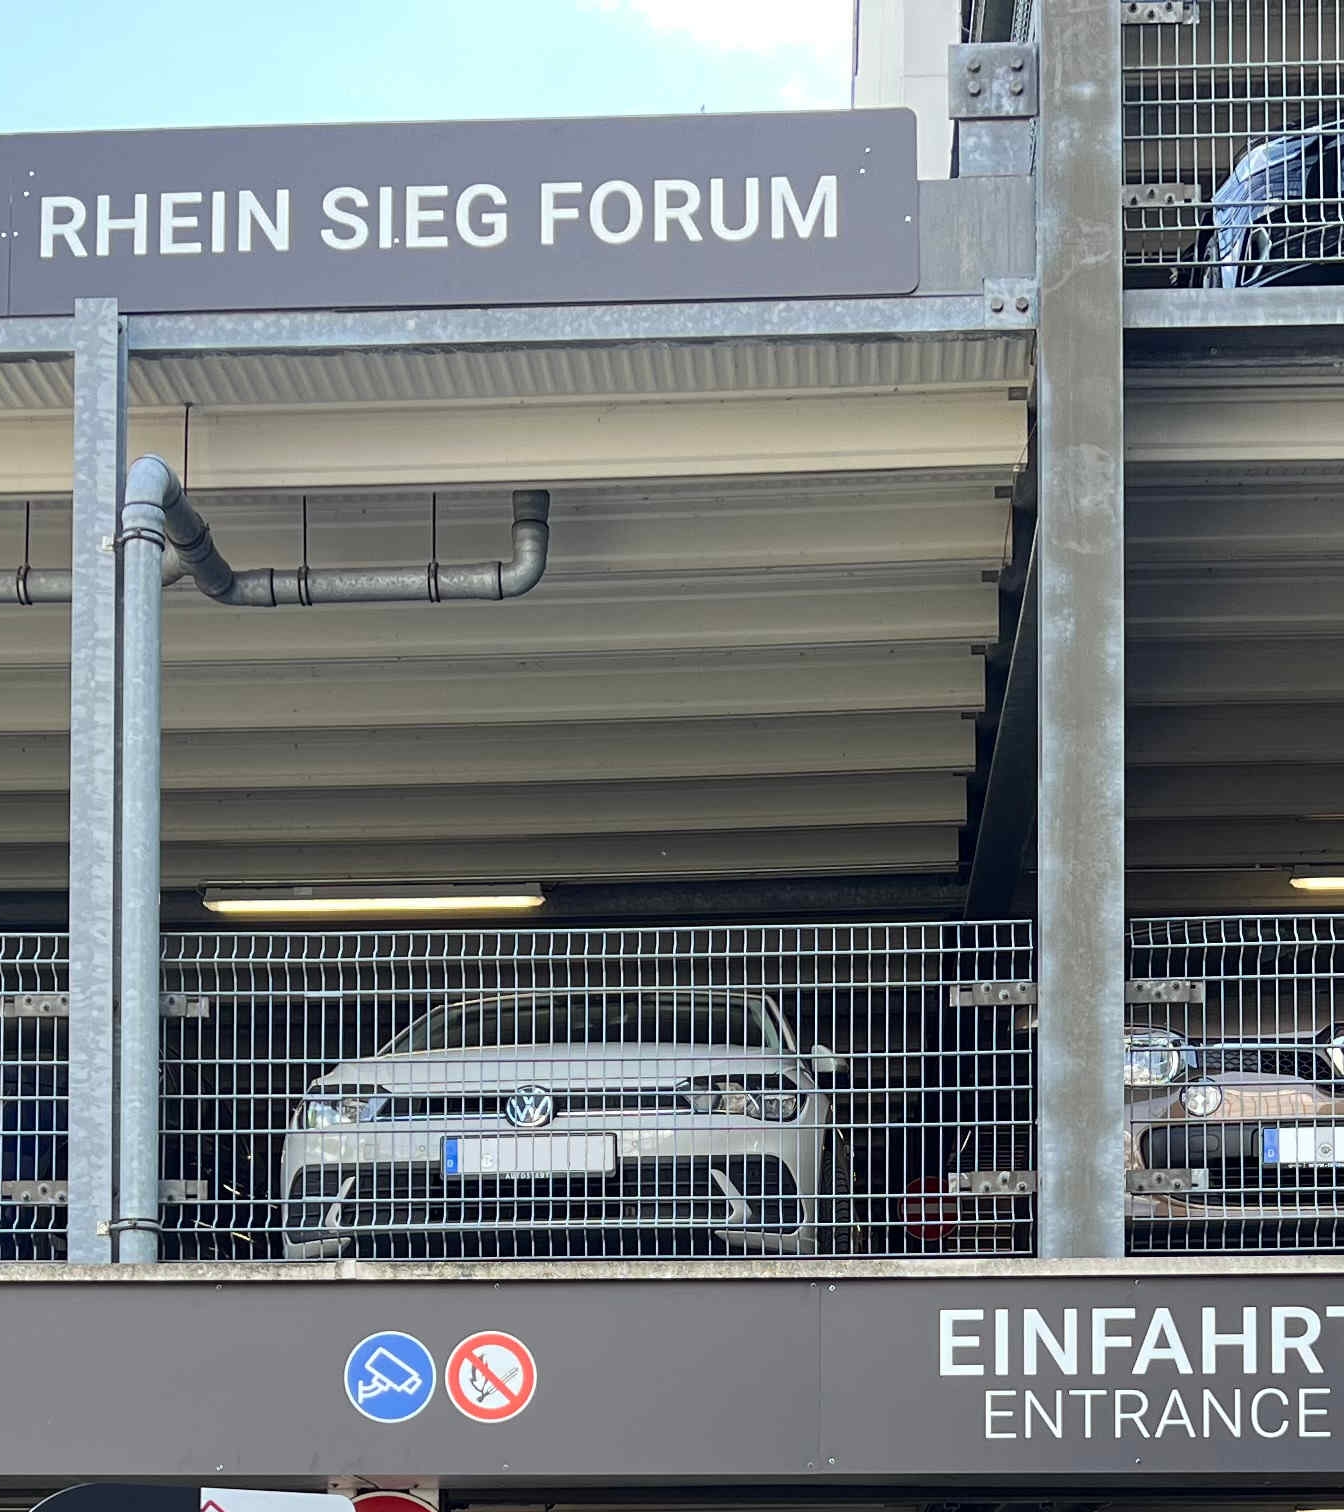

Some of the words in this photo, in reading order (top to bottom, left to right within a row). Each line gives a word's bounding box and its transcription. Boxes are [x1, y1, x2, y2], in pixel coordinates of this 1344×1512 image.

[39, 188, 290, 259] RHEIN
[320, 181, 509, 251] SIEG
[540, 175, 839, 245] FORUM
[984, 1388, 1331, 1439] ENTRANCE
